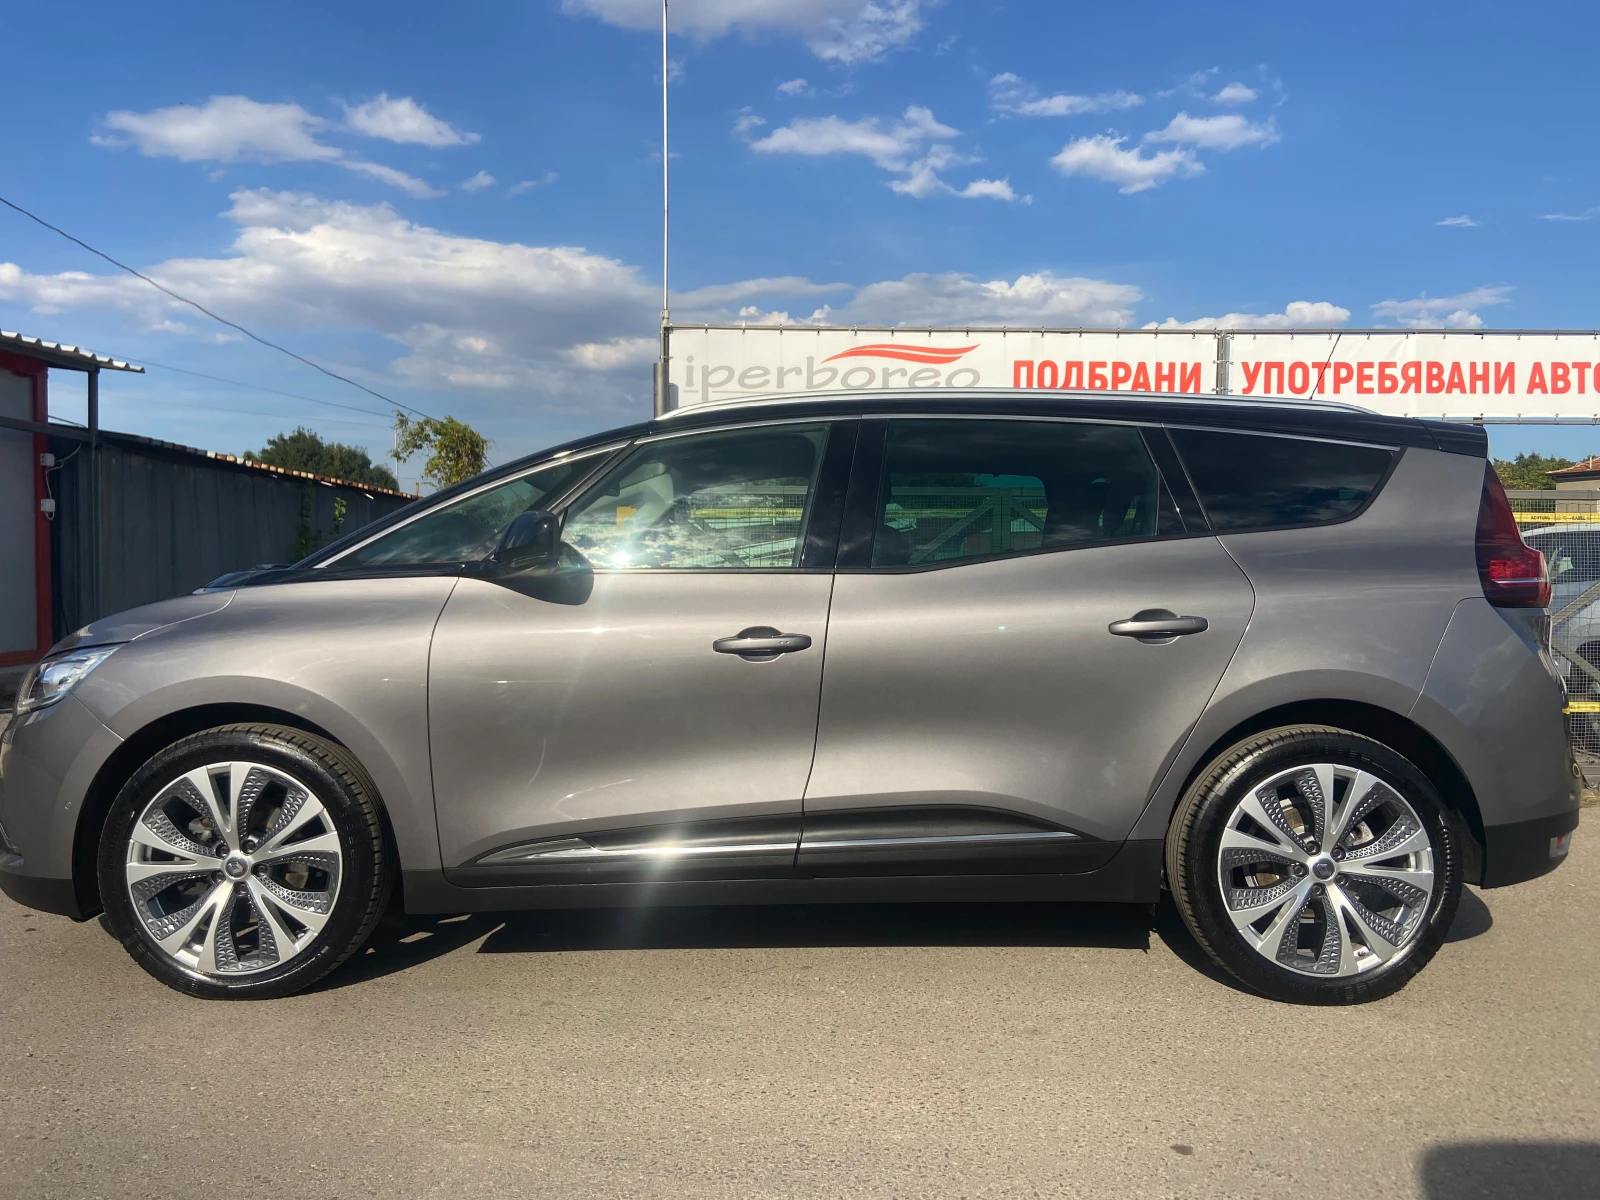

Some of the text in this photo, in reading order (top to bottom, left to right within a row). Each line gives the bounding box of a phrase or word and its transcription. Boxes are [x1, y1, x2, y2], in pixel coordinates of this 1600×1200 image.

[685, 355, 981, 402] iperboreo
[1013, 360, 1202, 394] ПОДБРАНИ
[1241, 361, 1516, 395] УПОТРЕБЯВАНИ
